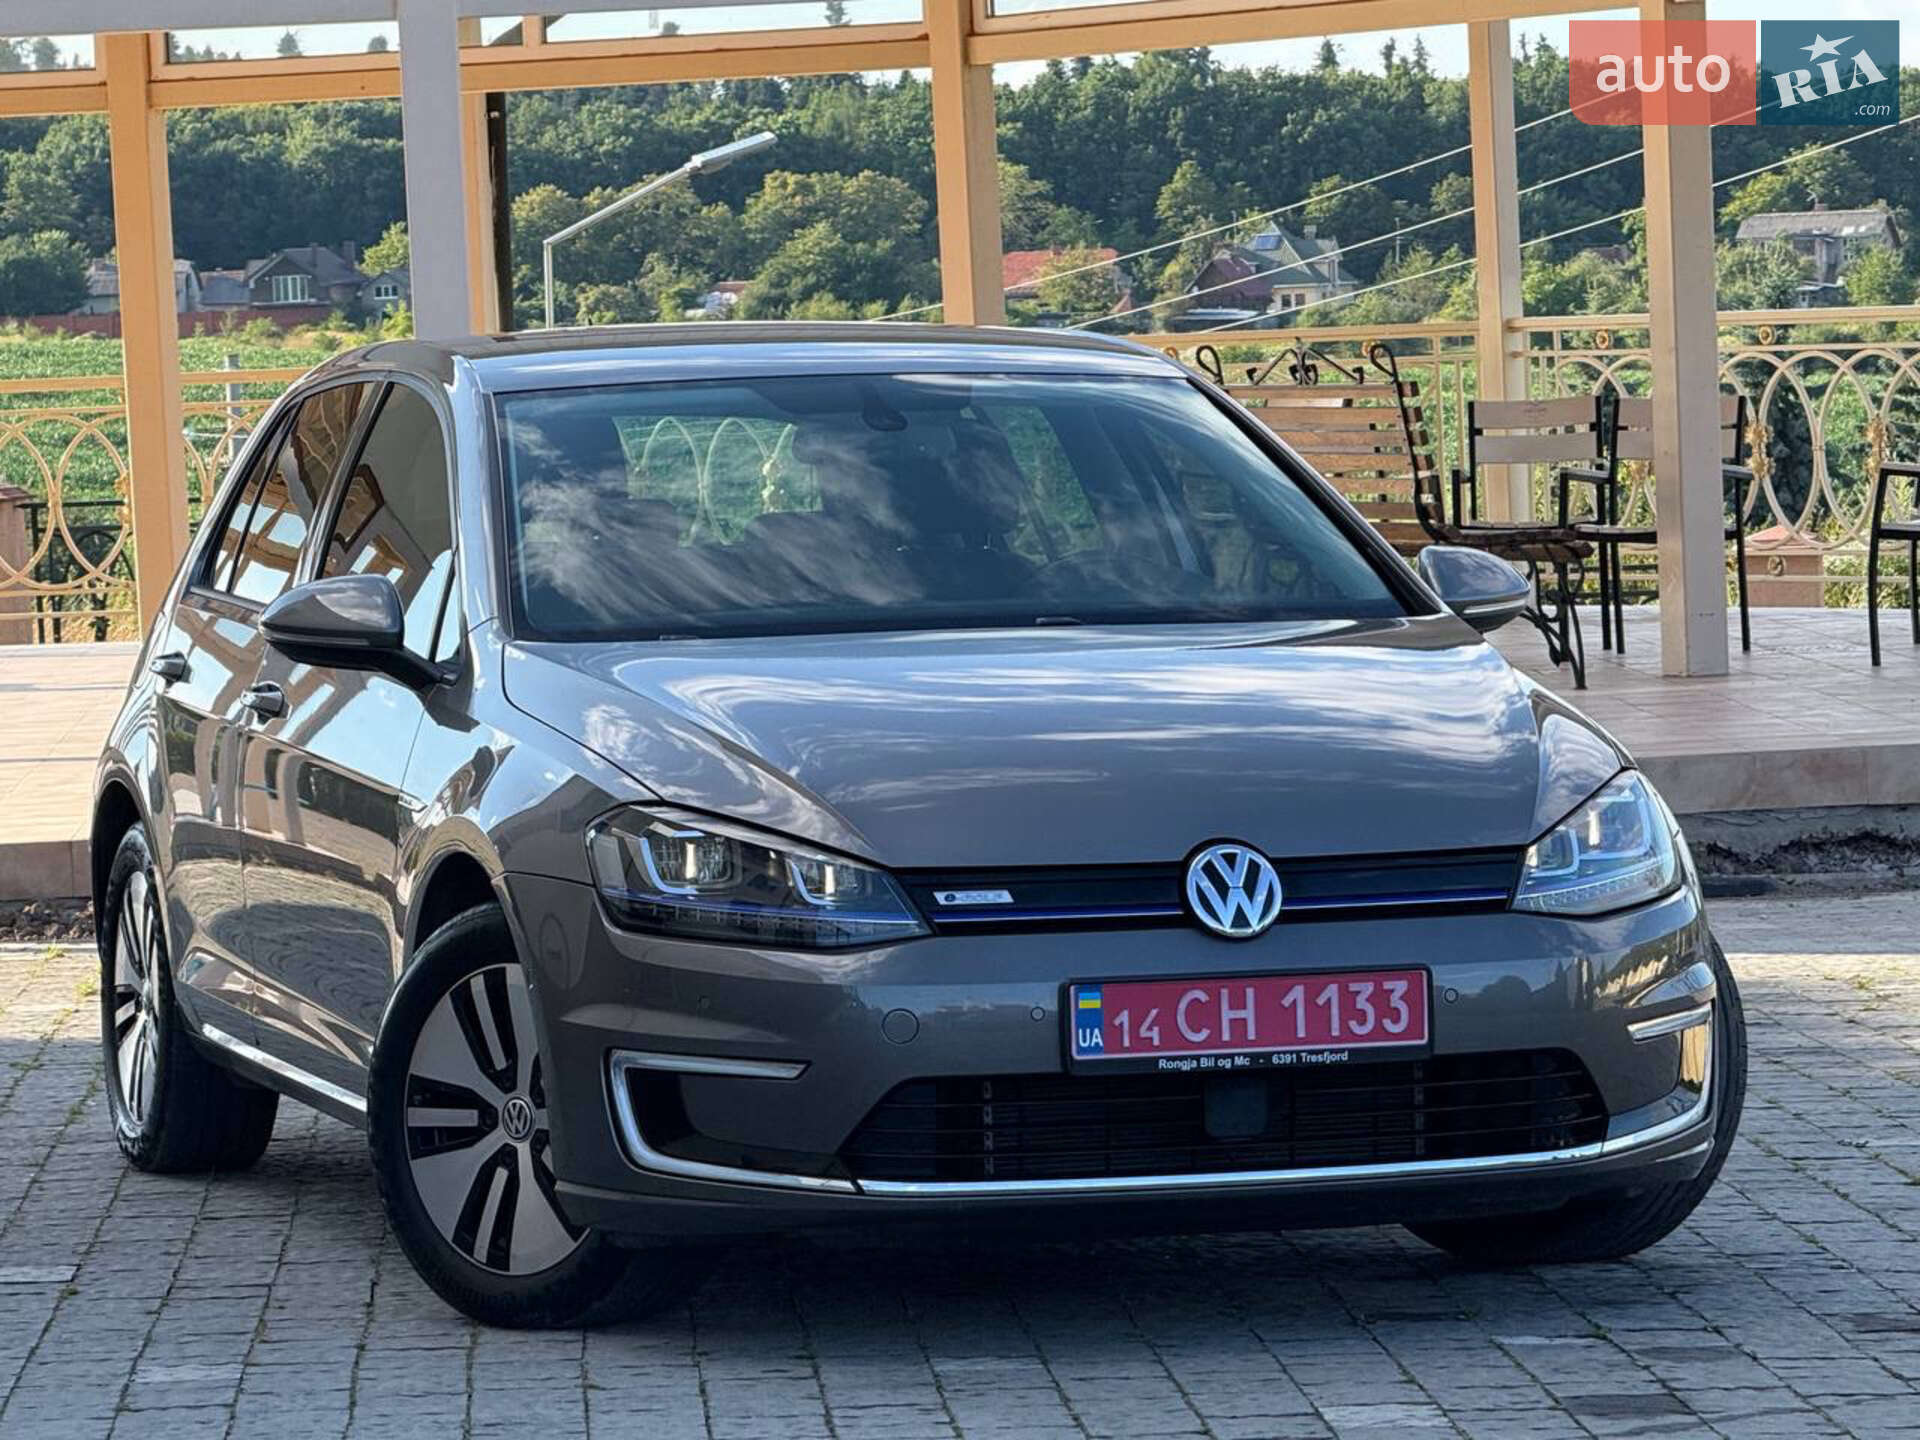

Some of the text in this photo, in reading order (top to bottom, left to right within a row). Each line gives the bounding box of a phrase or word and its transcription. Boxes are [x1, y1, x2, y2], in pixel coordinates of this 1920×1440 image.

[1113, 980, 1409, 1047] 14 CH 1133
[1078, 1029, 1103, 1048] UA
[1158, 1058, 1198, 1071] Rongja
[1200, 1057, 1215, 1067] Bil
[1217, 1058, 1231, 1069] og
[1233, 1055, 1250, 1066] Mc
[1272, 1053, 1297, 1064] 6391
[1300, 1051, 1348, 1064] Tresfjord
